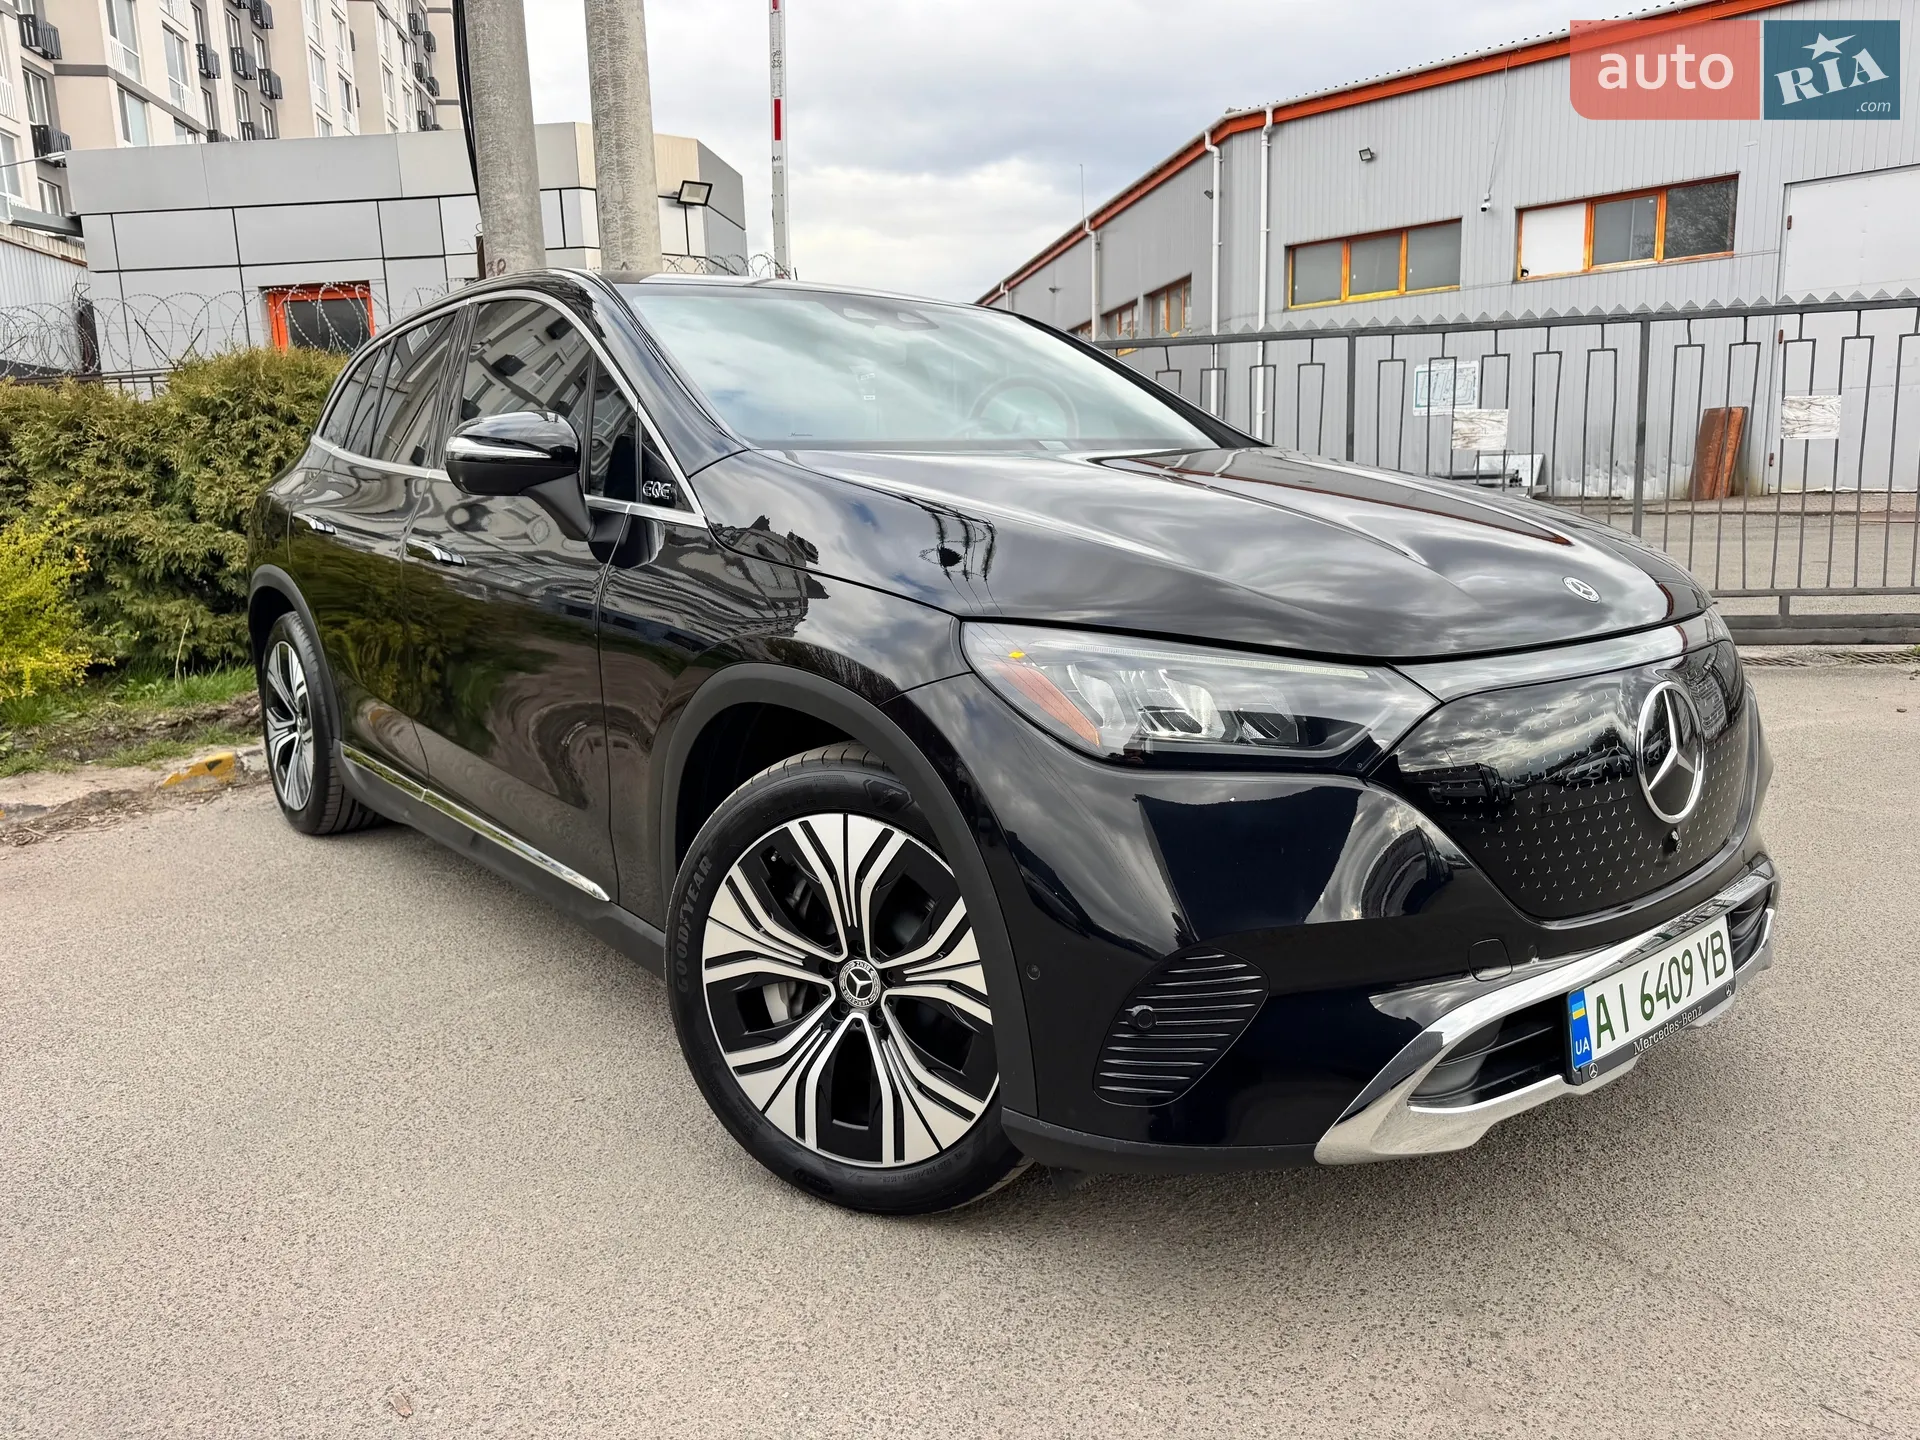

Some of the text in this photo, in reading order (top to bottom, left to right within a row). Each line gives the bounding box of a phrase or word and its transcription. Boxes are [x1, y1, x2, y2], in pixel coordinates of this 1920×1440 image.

[642, 480, 671, 500] EQE
[676, 855, 713, 993] GOODYEAR
[1596, 930, 1727, 1049] AI 6409 YB
[1575, 1036, 1590, 1055] UA
[1633, 1005, 1703, 1055] Mercedes-Benz
